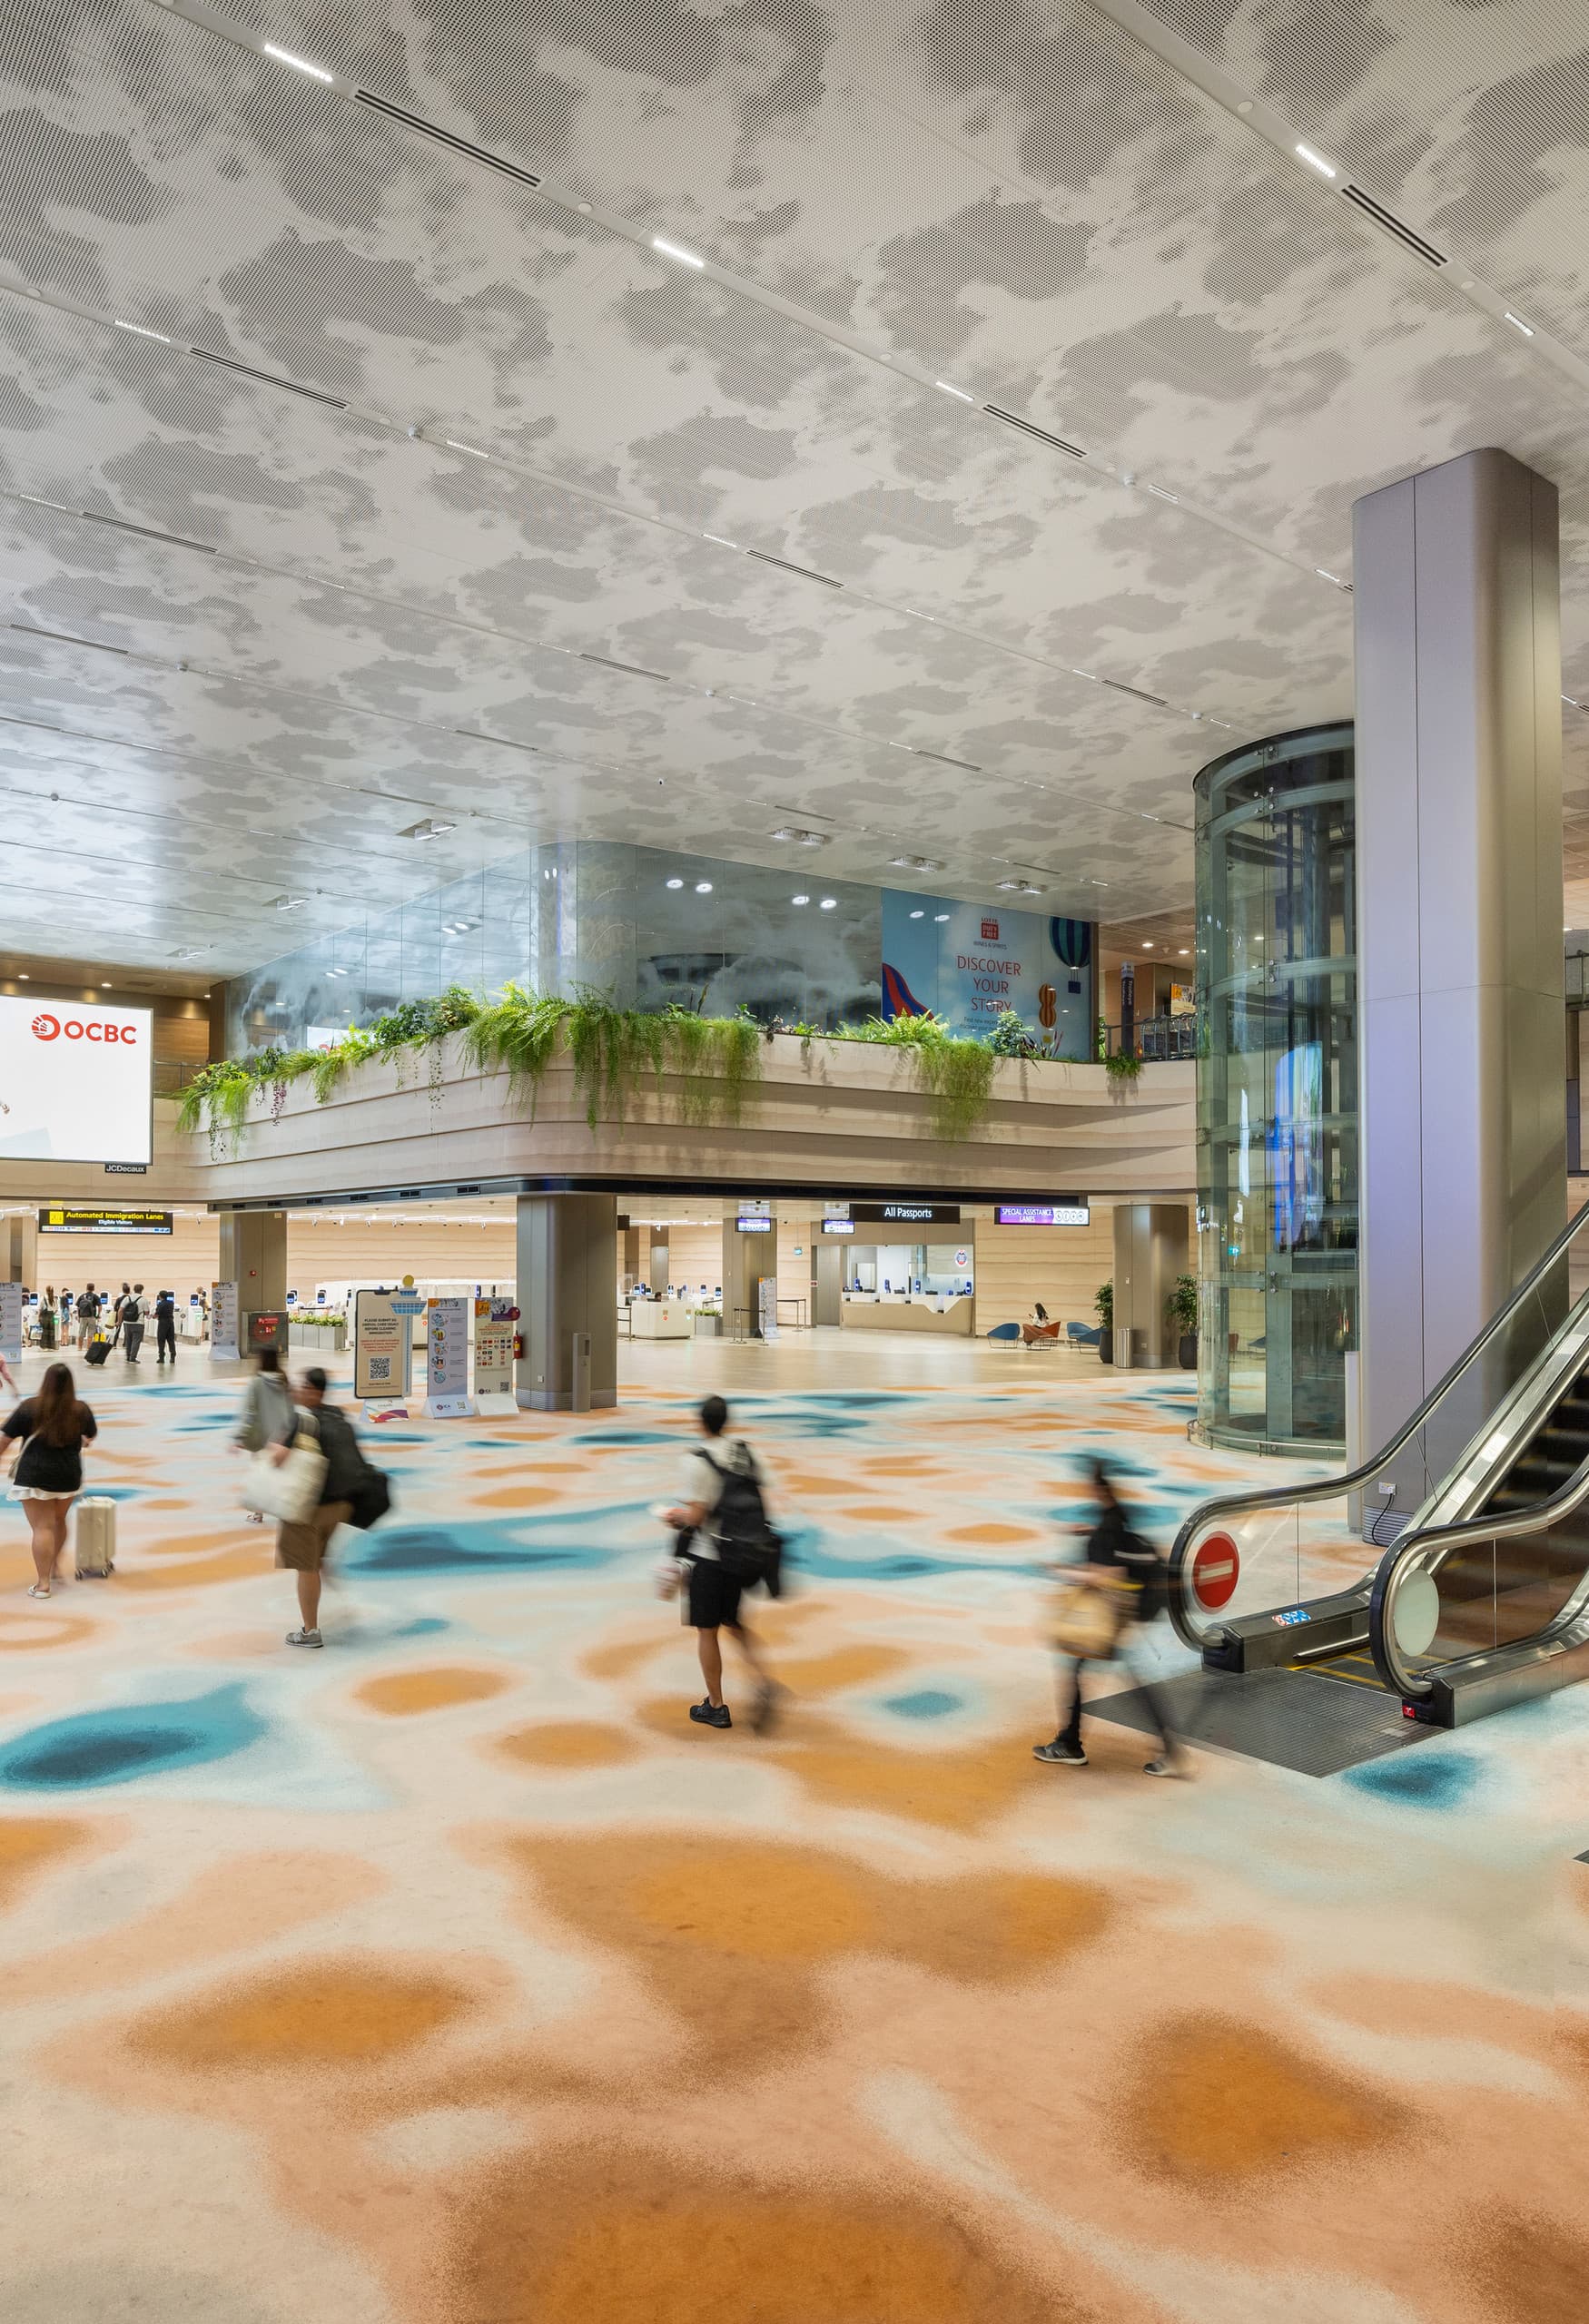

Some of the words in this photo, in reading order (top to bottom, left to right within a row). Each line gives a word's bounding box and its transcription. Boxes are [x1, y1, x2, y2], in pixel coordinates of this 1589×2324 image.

[957, 955, 1022, 976] DISCOVER
[973, 978, 1009, 994] YOUR
[972, 998, 1012, 1013] STORY
[64, 1020, 137, 1045] OCBC
[106, 1165, 145, 1173] JCDecaux
[884, 1207, 896, 1217] All
[897, 1208, 933, 1219] Passports
